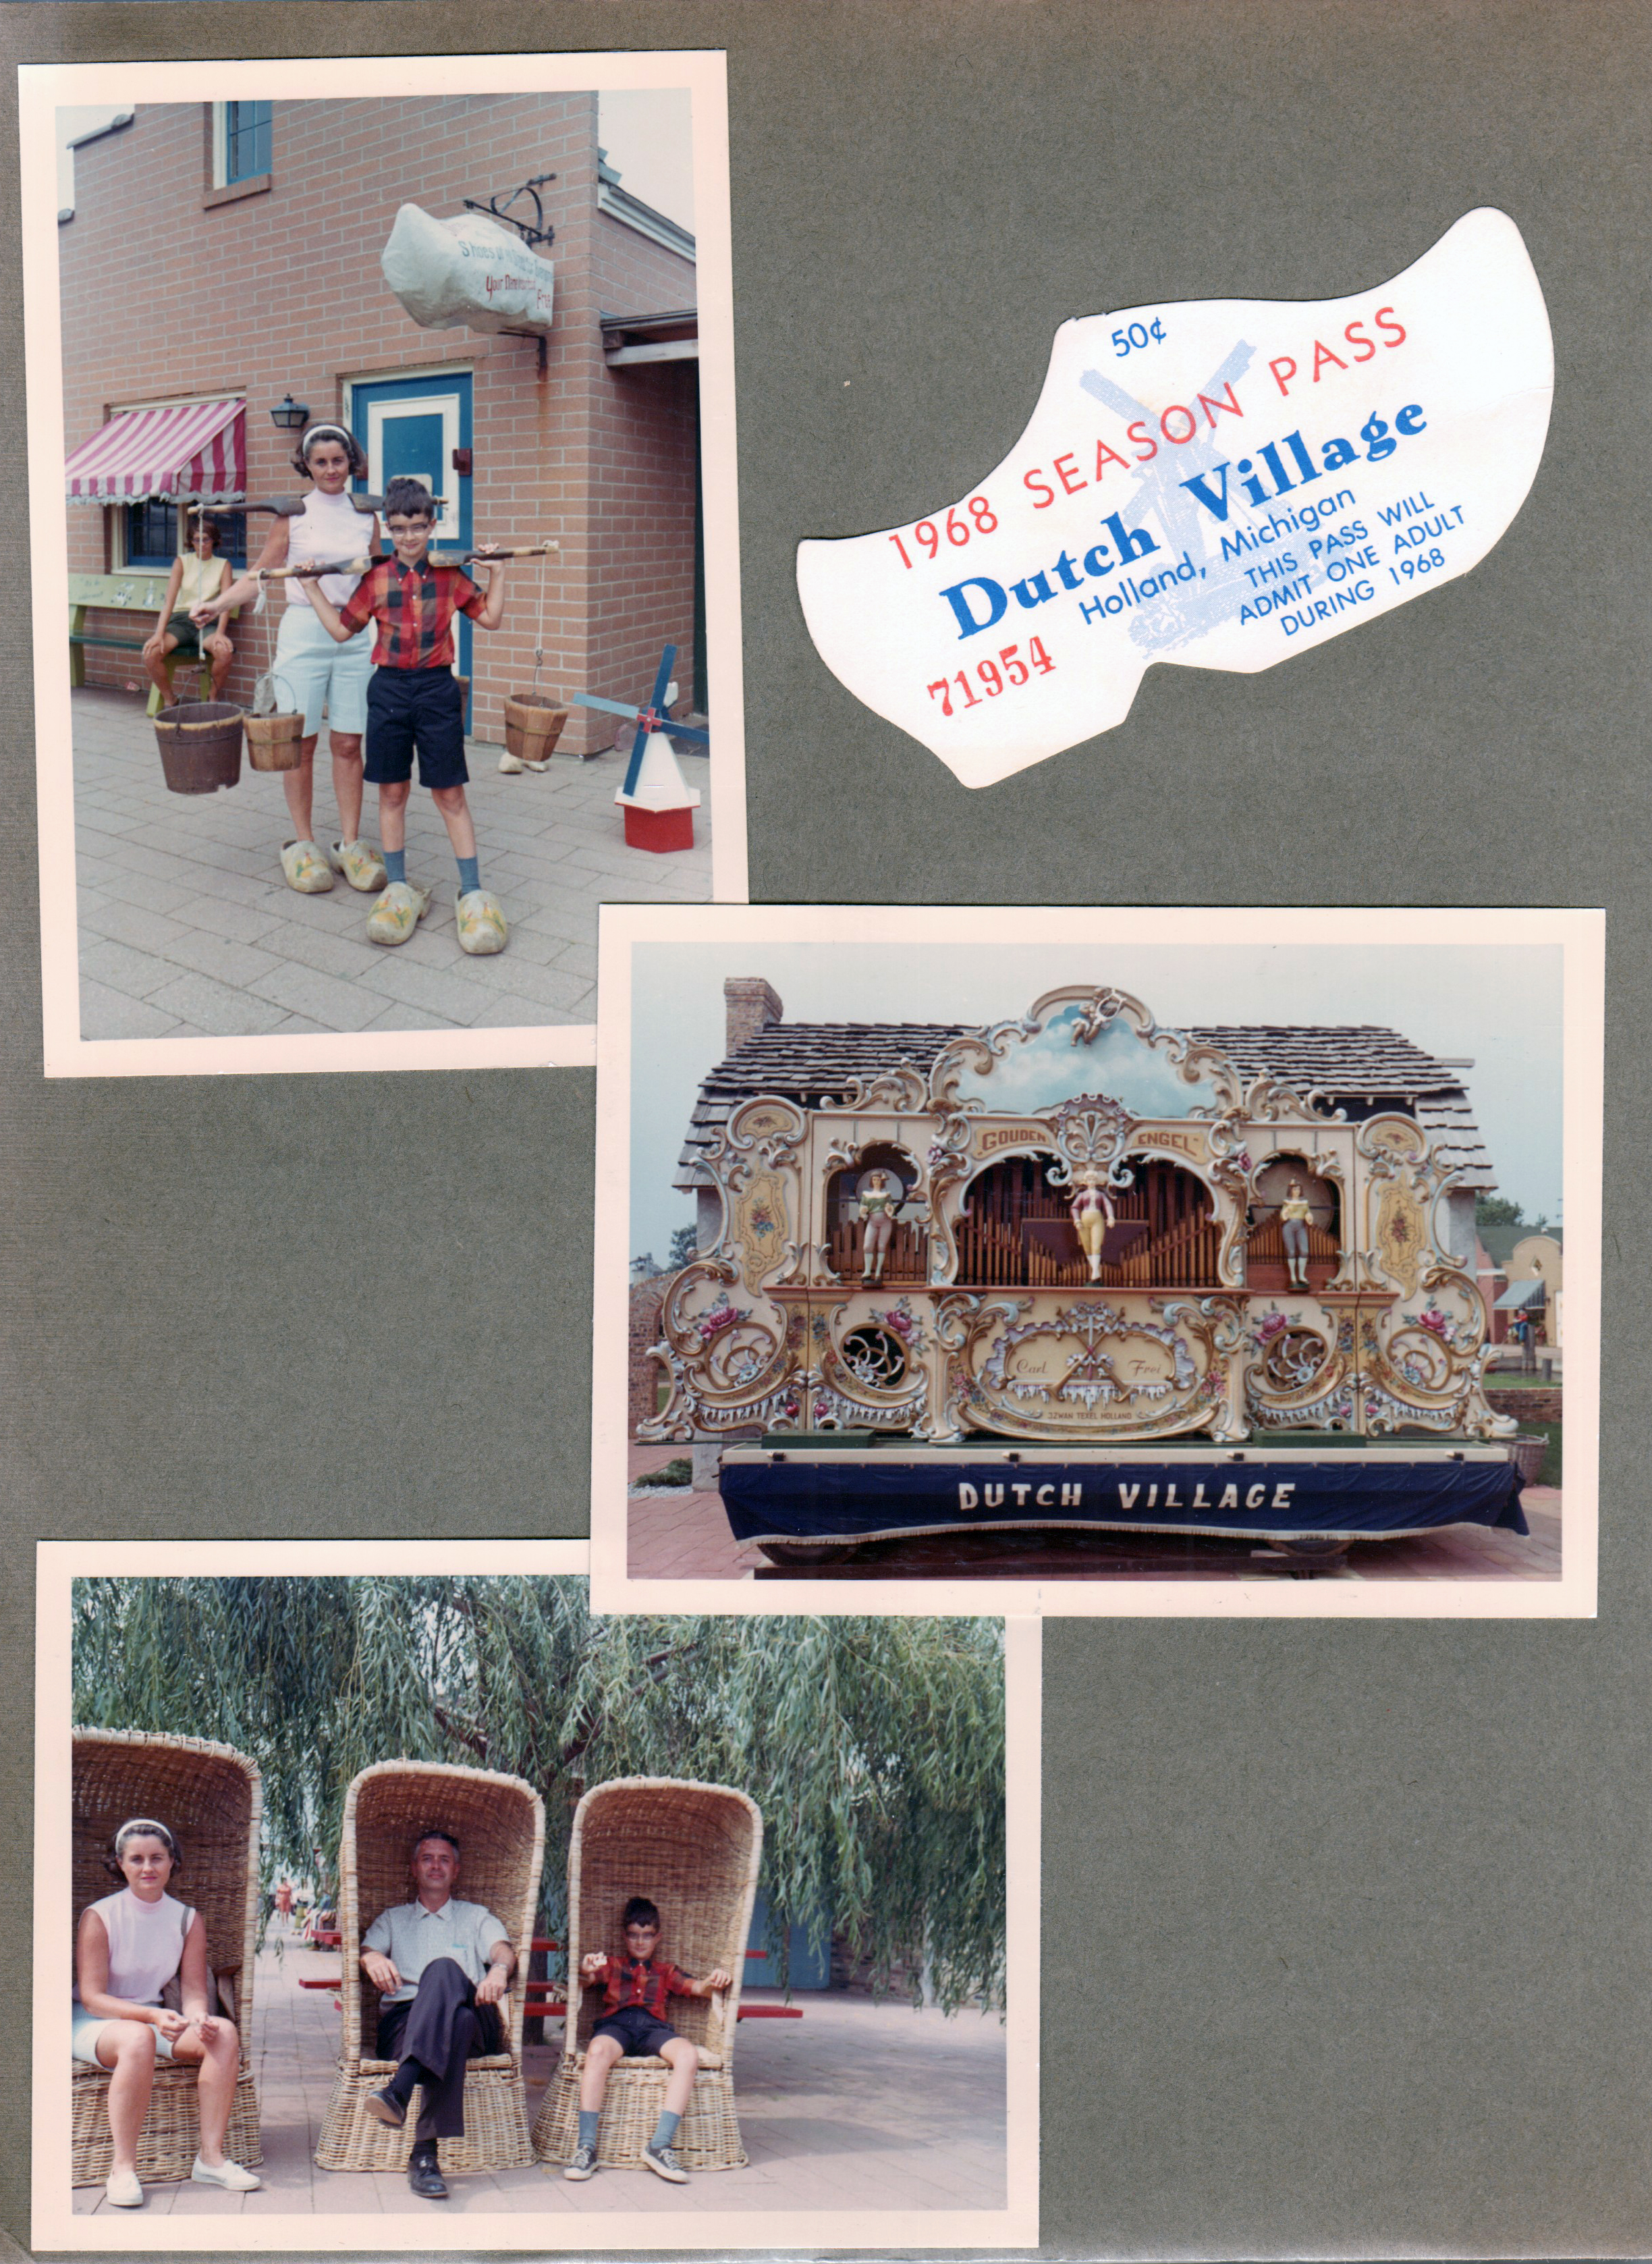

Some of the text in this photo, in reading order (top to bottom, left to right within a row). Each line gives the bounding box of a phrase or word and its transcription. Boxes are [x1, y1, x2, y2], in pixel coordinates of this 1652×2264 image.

[458, 240, 495, 259] Shoes
[1111, 316, 1167, 357] 50¢
[889, 307, 1406, 569] 1968 SEASON PASS
[939, 404, 1427, 640] Dutch Village
[1079, 489, 1356, 624] Holland, Michigan
[1244, 492, 1435, 588] THIS PASS WILL
[1240, 506, 1464, 626] ADMIT ONE ADULT
[1280, 548, 1445, 637] DURING 1968
[927, 635, 1056, 716] 71954
[982, 1129, 1198, 1156] GOUDEN ENGEL
[1016, 1359, 1162, 1376] Carl Frei
[1076, 1411, 1098, 1420] TEXEL
[1101, 1411, 1132, 1420] HOLLAND
[959, 1482, 1295, 1510] DUTCH VILLAGE
